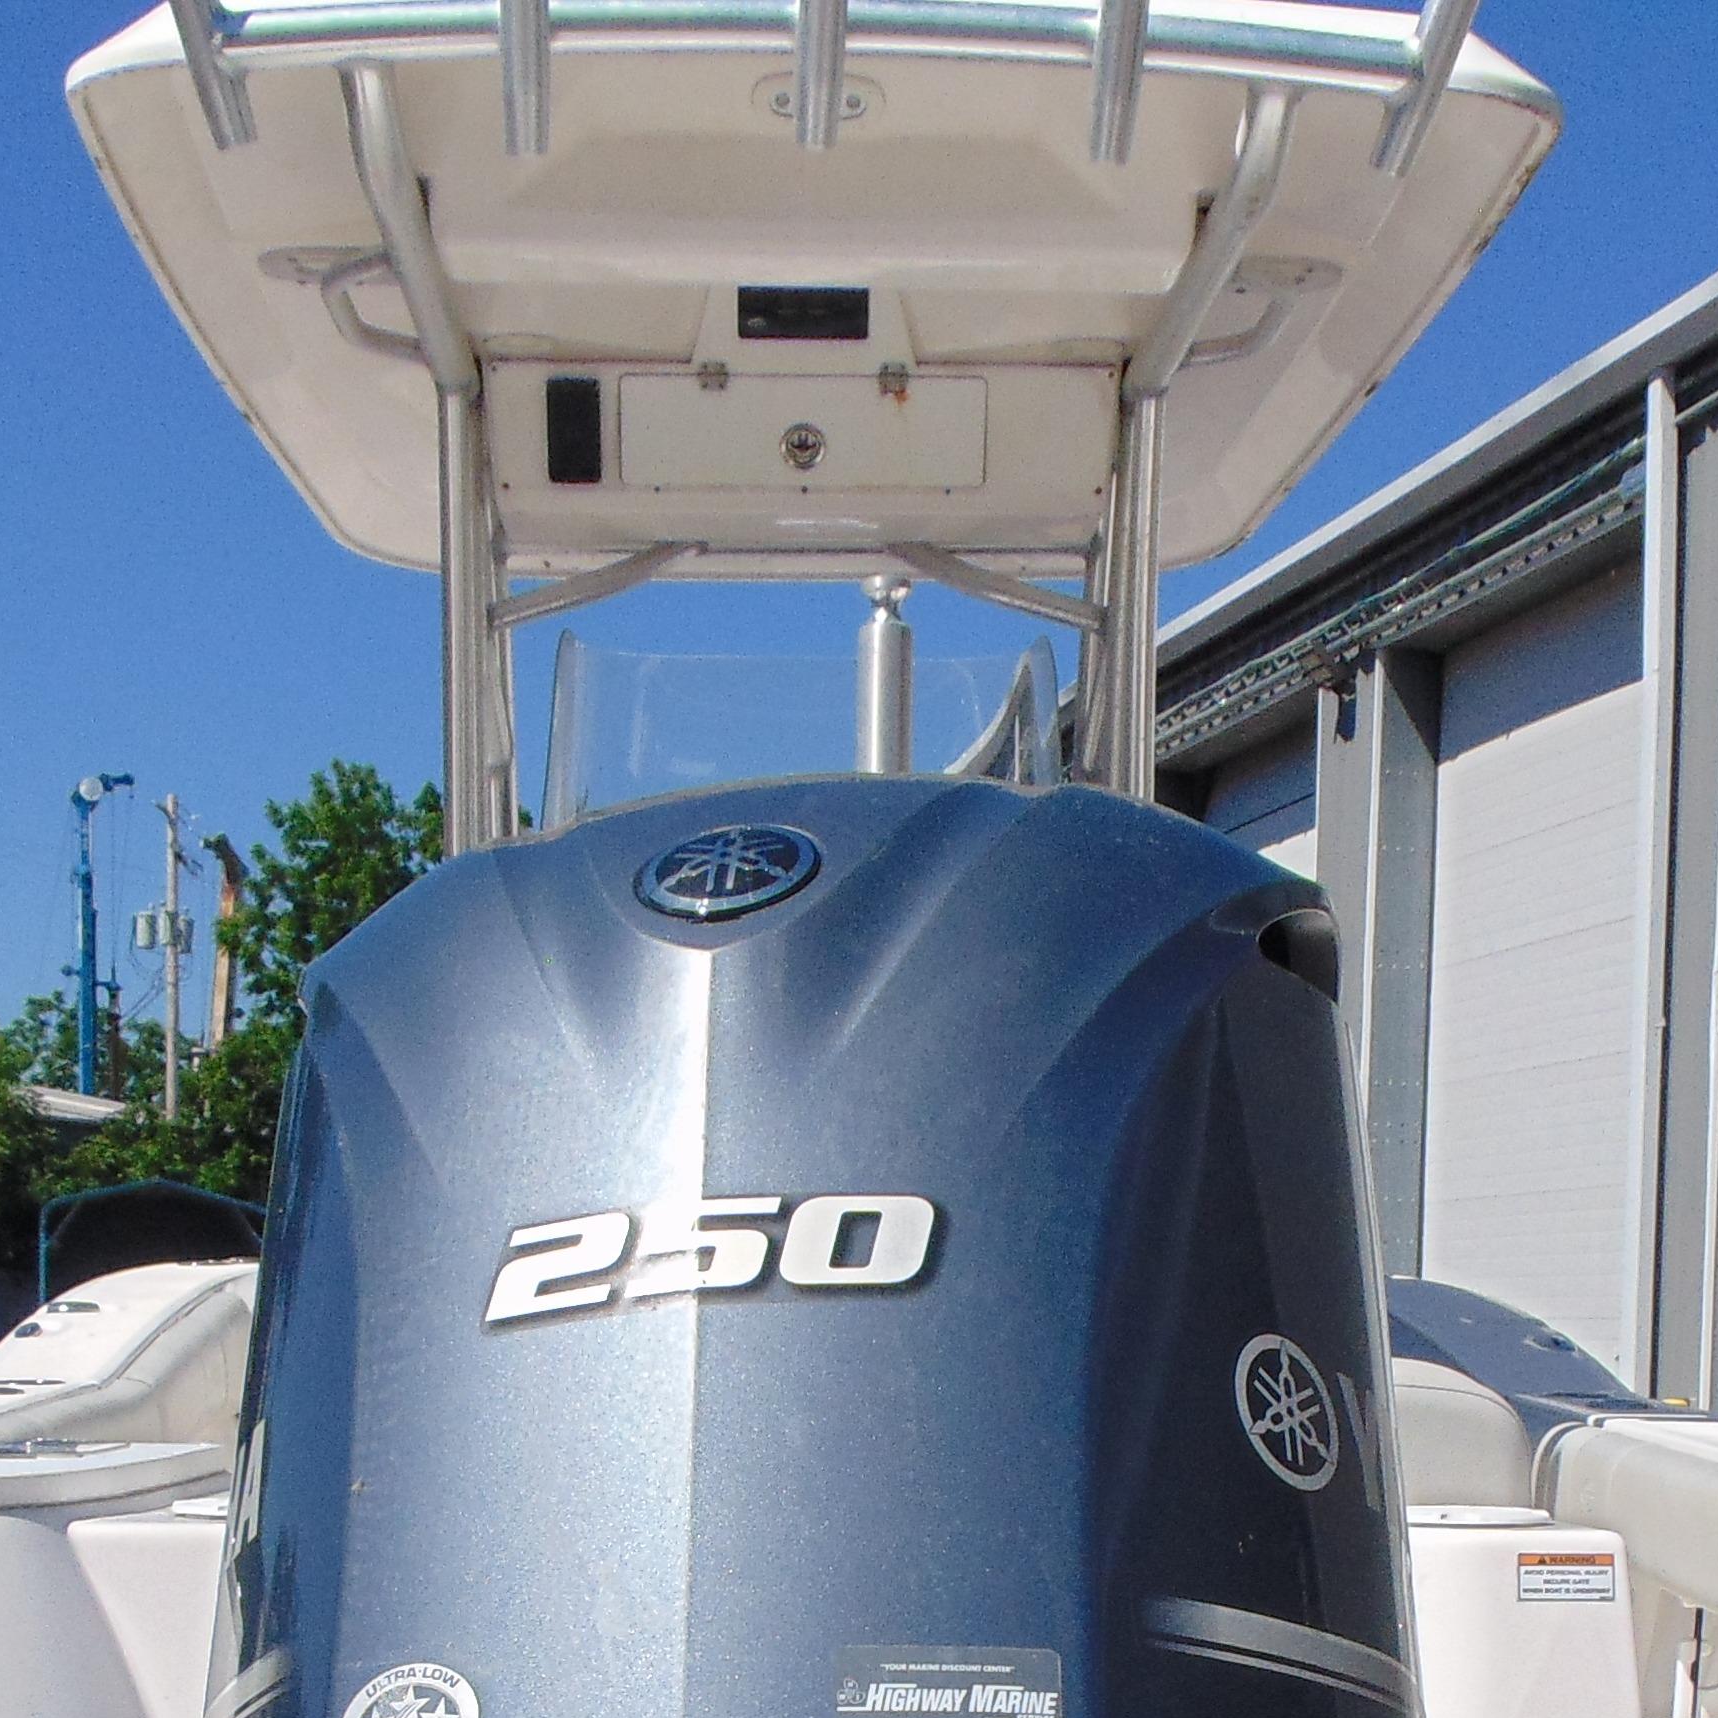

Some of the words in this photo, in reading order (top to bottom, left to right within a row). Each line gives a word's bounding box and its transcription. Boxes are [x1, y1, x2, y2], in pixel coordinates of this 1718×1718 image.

[485, 1196, 935, 1323] 250
[1549, 1556, 1595, 1564] WARNING
[941, 1664, 981, 1672] DISCOUNT
[865, 1683, 969, 1712] HIGHWAY
[968, 1684, 1058, 1715] MARINE
